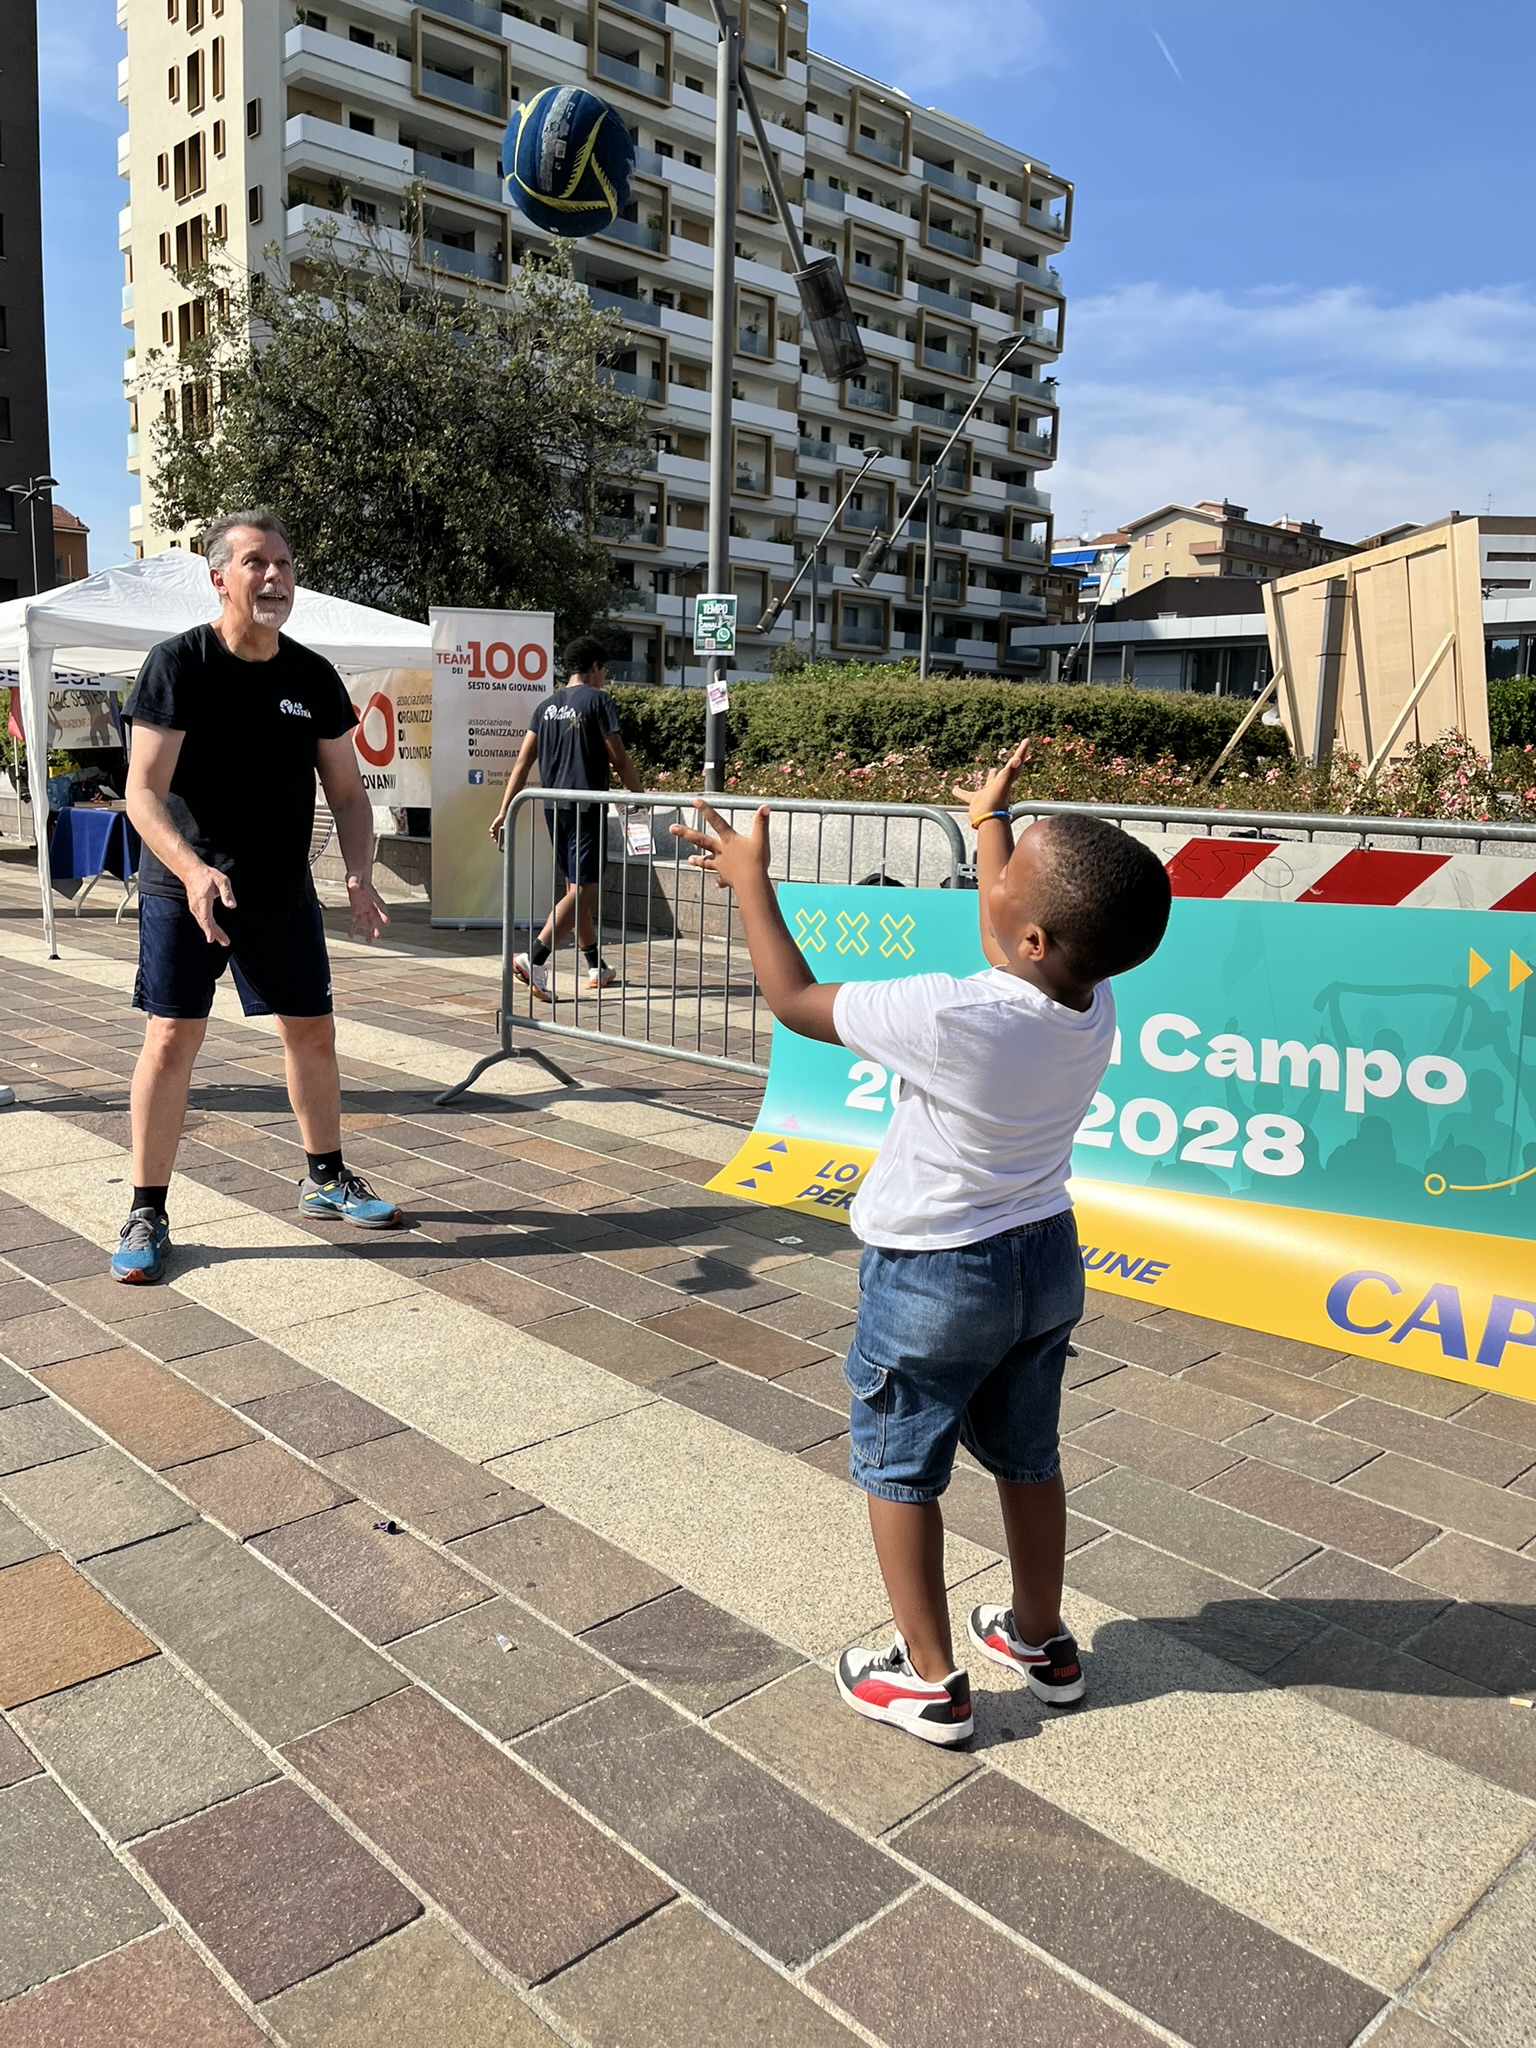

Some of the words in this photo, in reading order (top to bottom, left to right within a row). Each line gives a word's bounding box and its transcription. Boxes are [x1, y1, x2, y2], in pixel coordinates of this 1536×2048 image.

[703, 603, 728, 615] TEMPO
[436, 653, 471, 665] TEAM
[468, 641, 548, 681] 100
[468, 681, 491, 690] SESTO
[492, 682, 507, 691] SAN
[509, 683, 546, 692] GIOVANNI
[468, 718, 512, 726] associazione
[468, 749, 520, 758] VOLONTARIAT
[1140, 1013, 1467, 1113] Campo
[1074, 1091, 1305, 1176] 2028
[815, 1160, 859, 1183] LO
